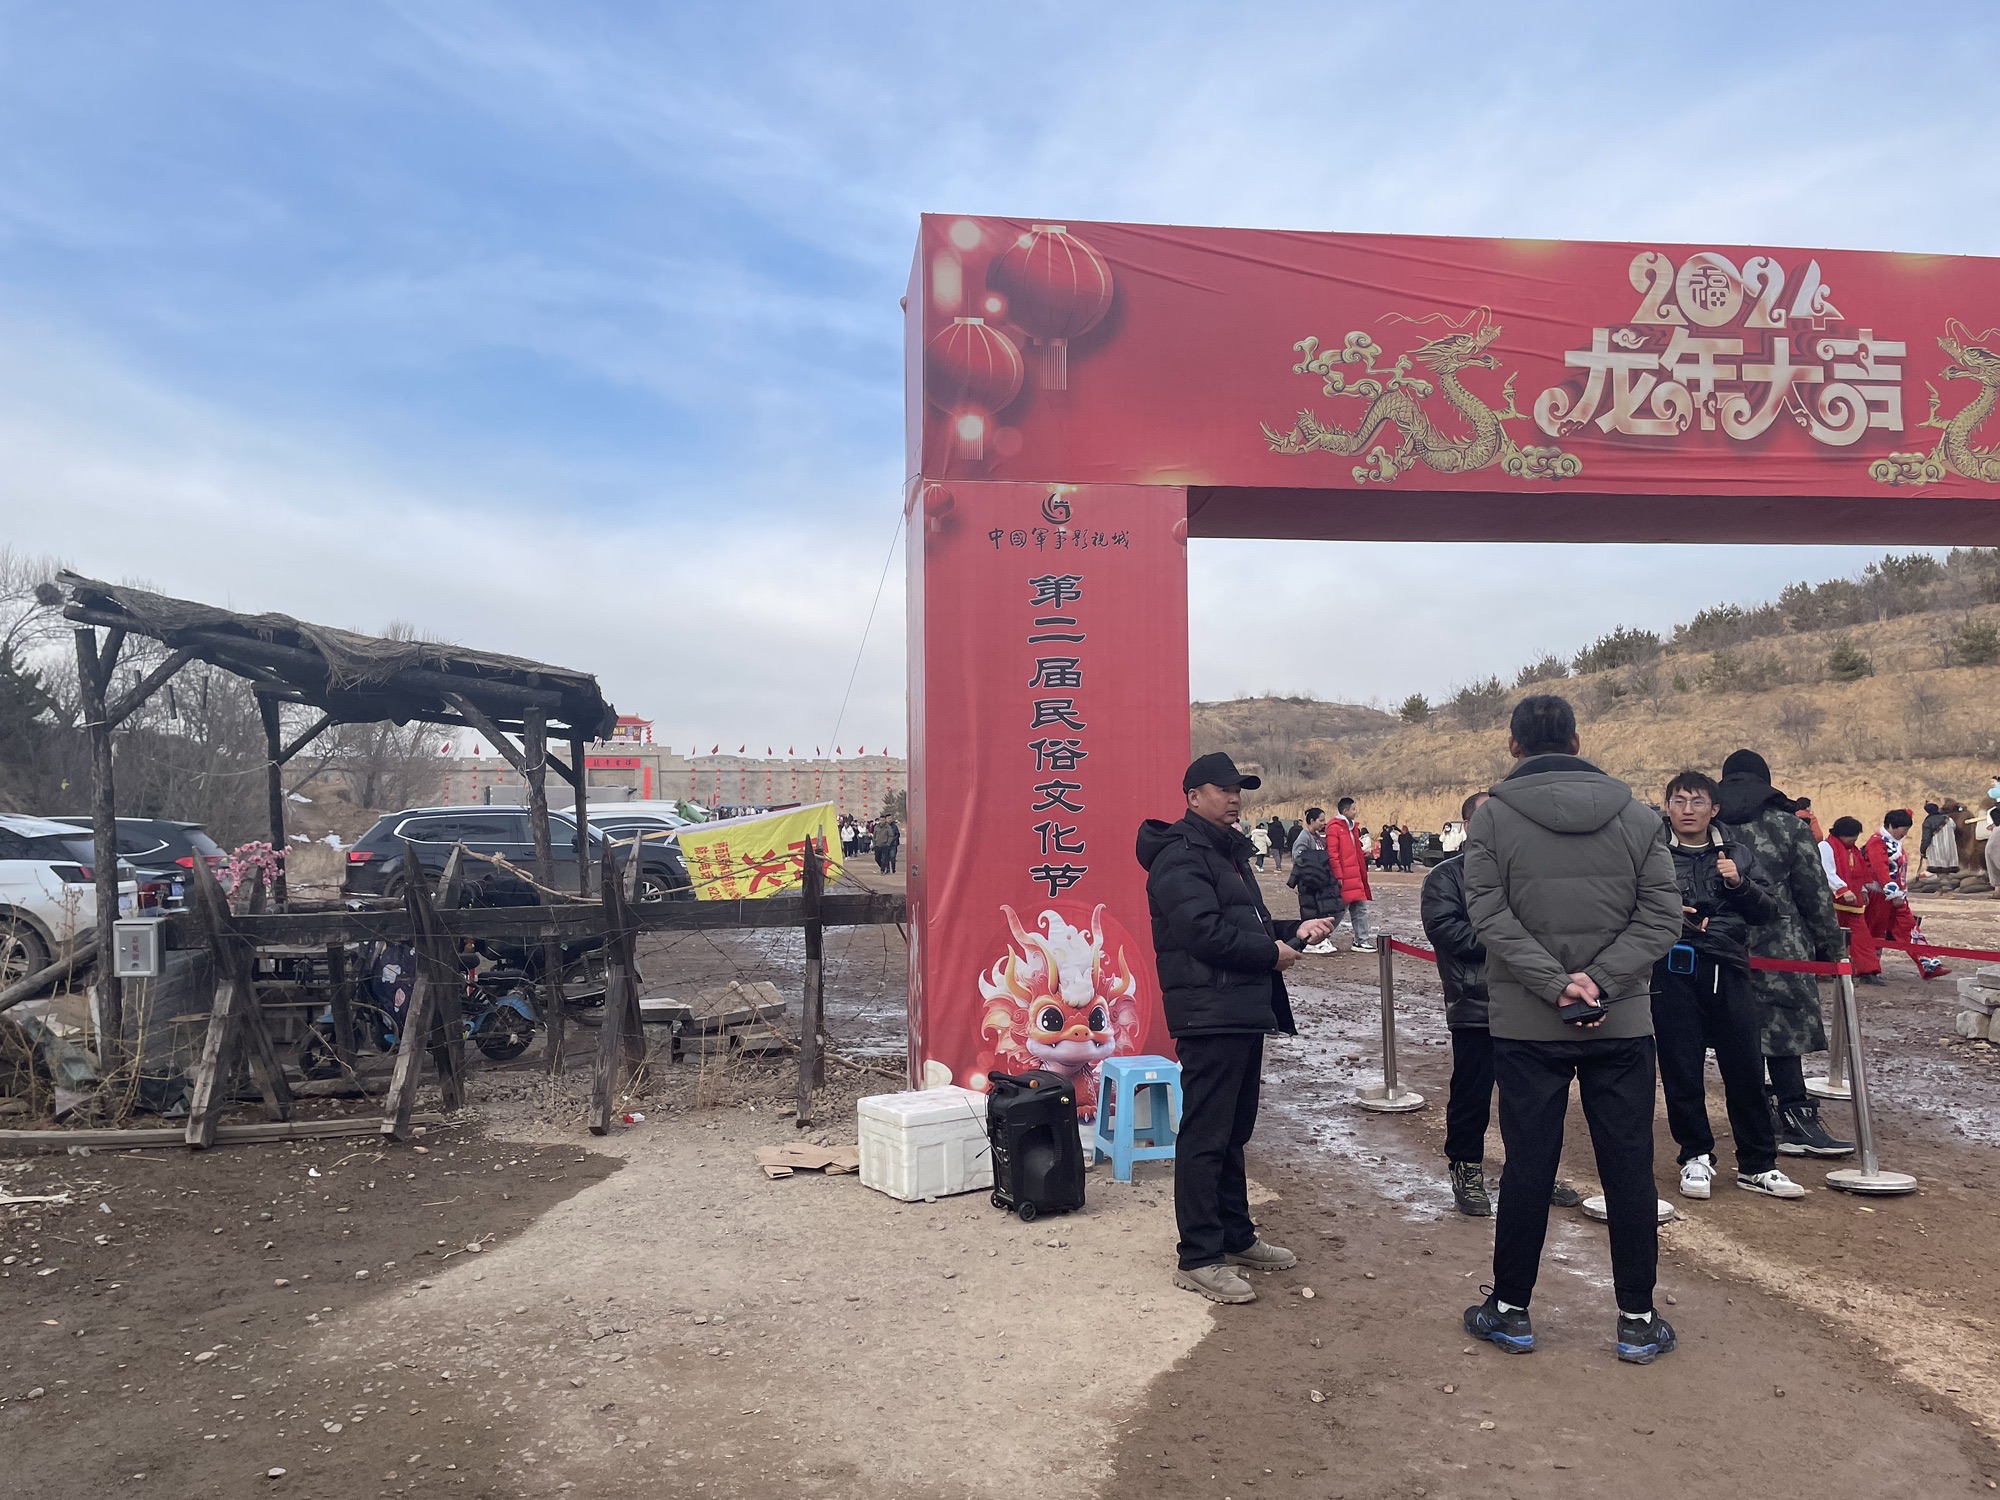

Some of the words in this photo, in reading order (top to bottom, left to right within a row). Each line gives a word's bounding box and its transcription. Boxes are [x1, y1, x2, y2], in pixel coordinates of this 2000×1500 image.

[1628, 251, 1845, 330] 2024
[1533, 327, 1906, 447] 龙年大吉
[1028, 573, 1088, 898] 第二届民俗文化节
